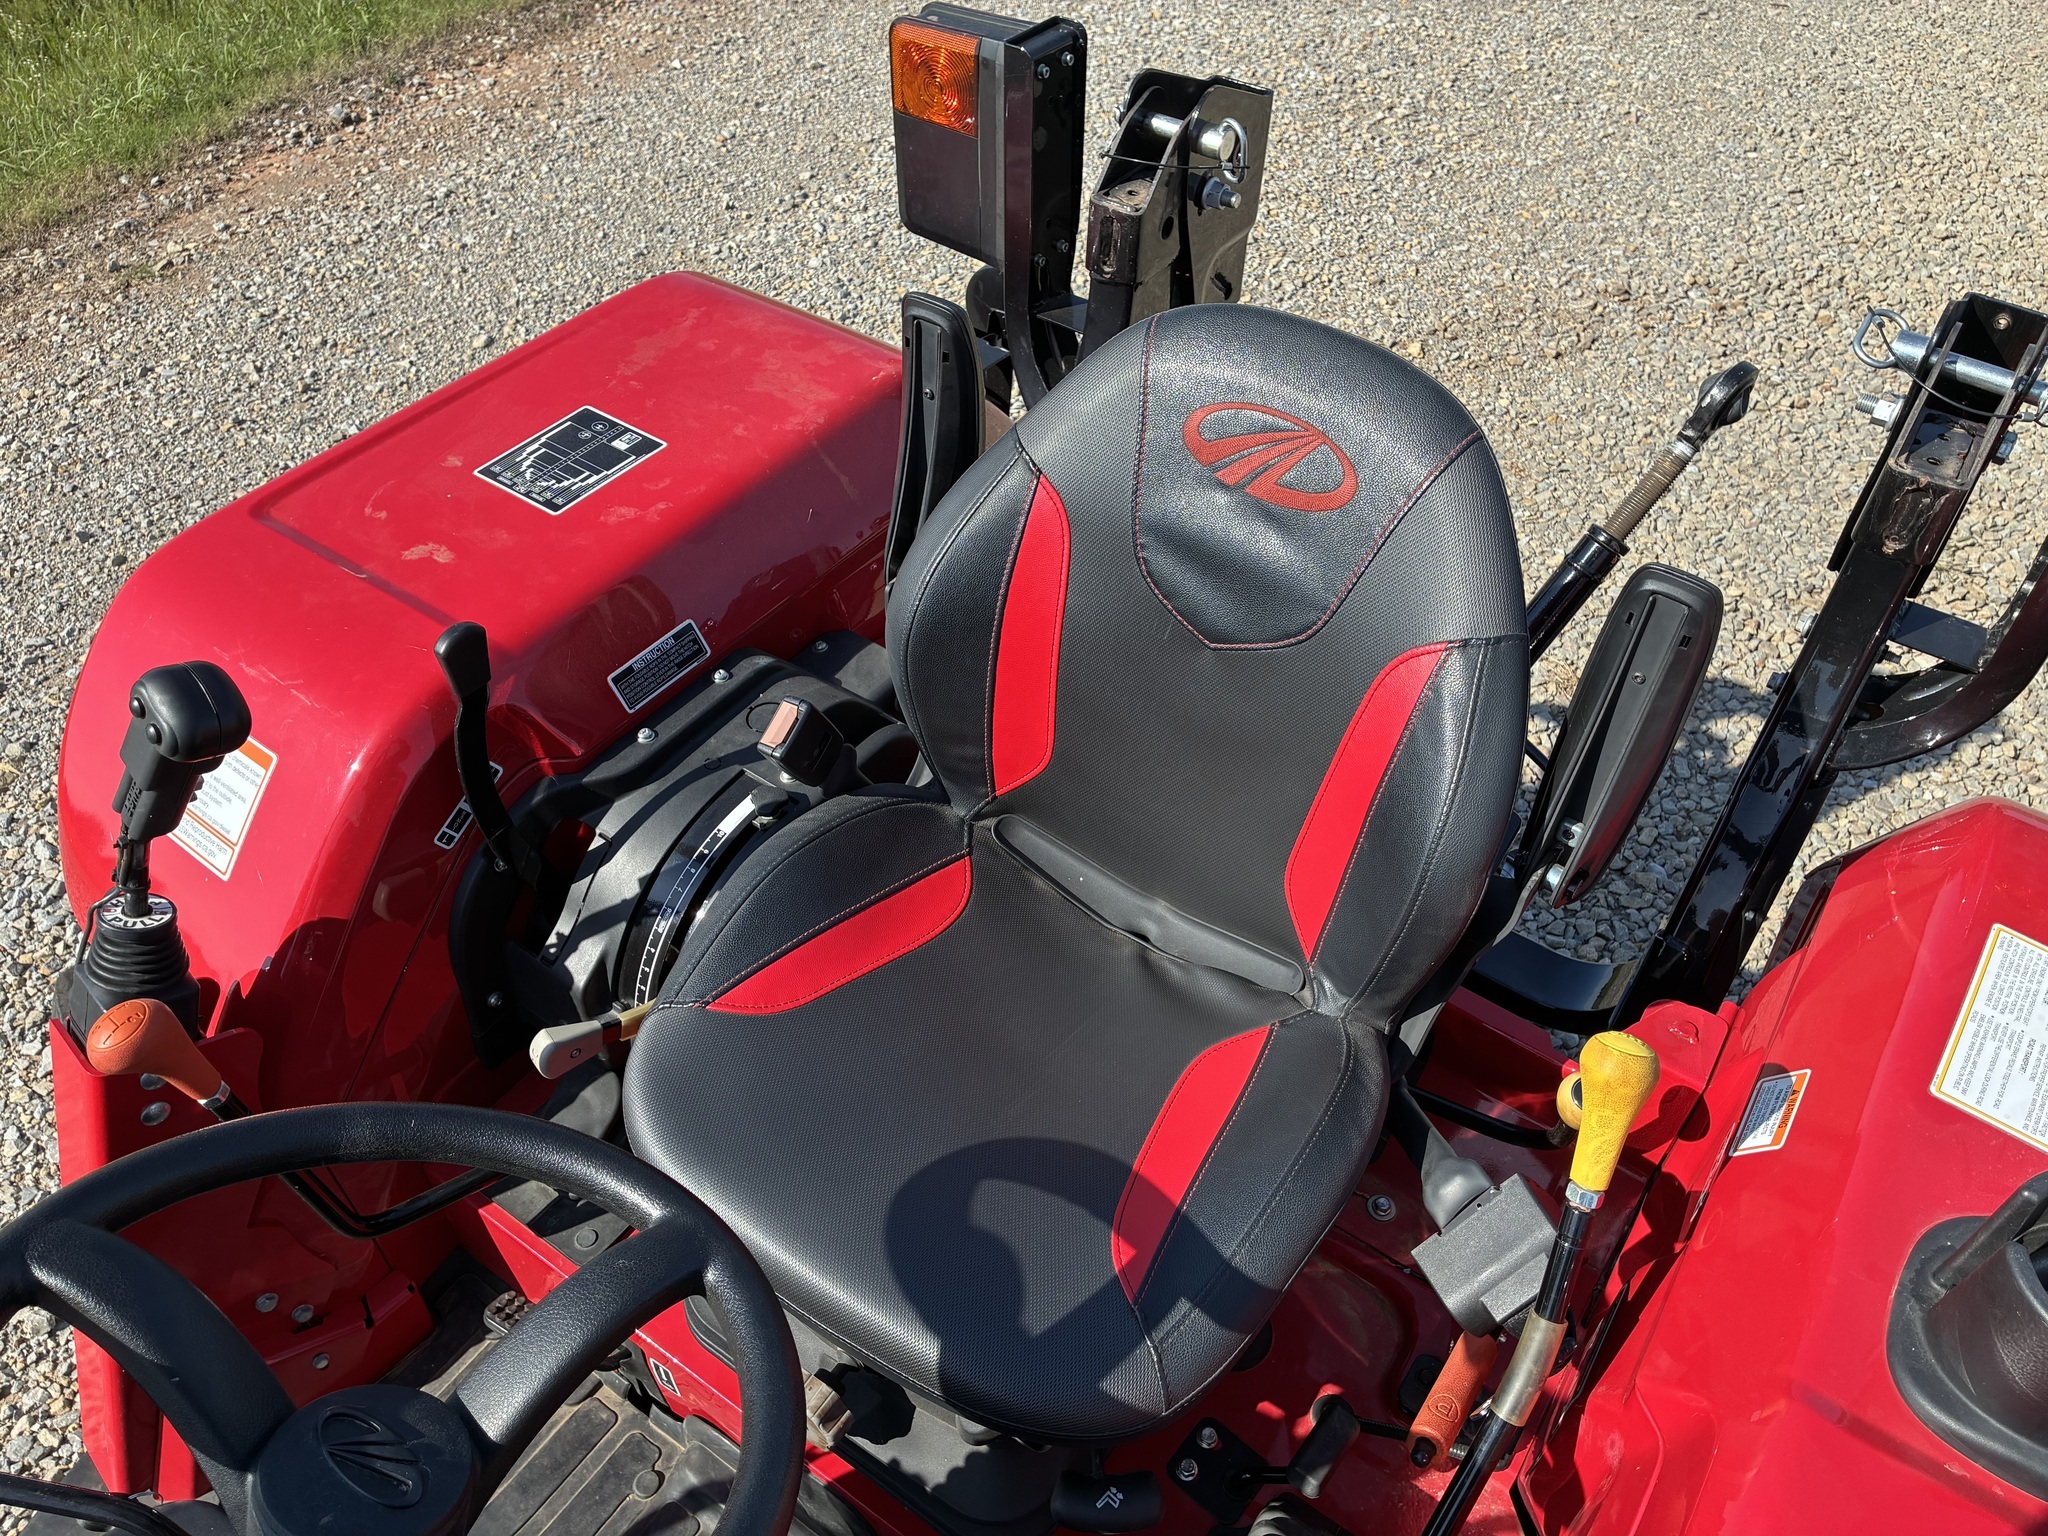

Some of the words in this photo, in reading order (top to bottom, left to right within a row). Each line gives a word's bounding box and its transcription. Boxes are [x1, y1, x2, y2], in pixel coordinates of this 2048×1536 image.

[631, 636, 675, 671] INSTRUCTION
[108, 915, 164, 928] PULL
[1778, 1097, 1797, 1128] WARNING
